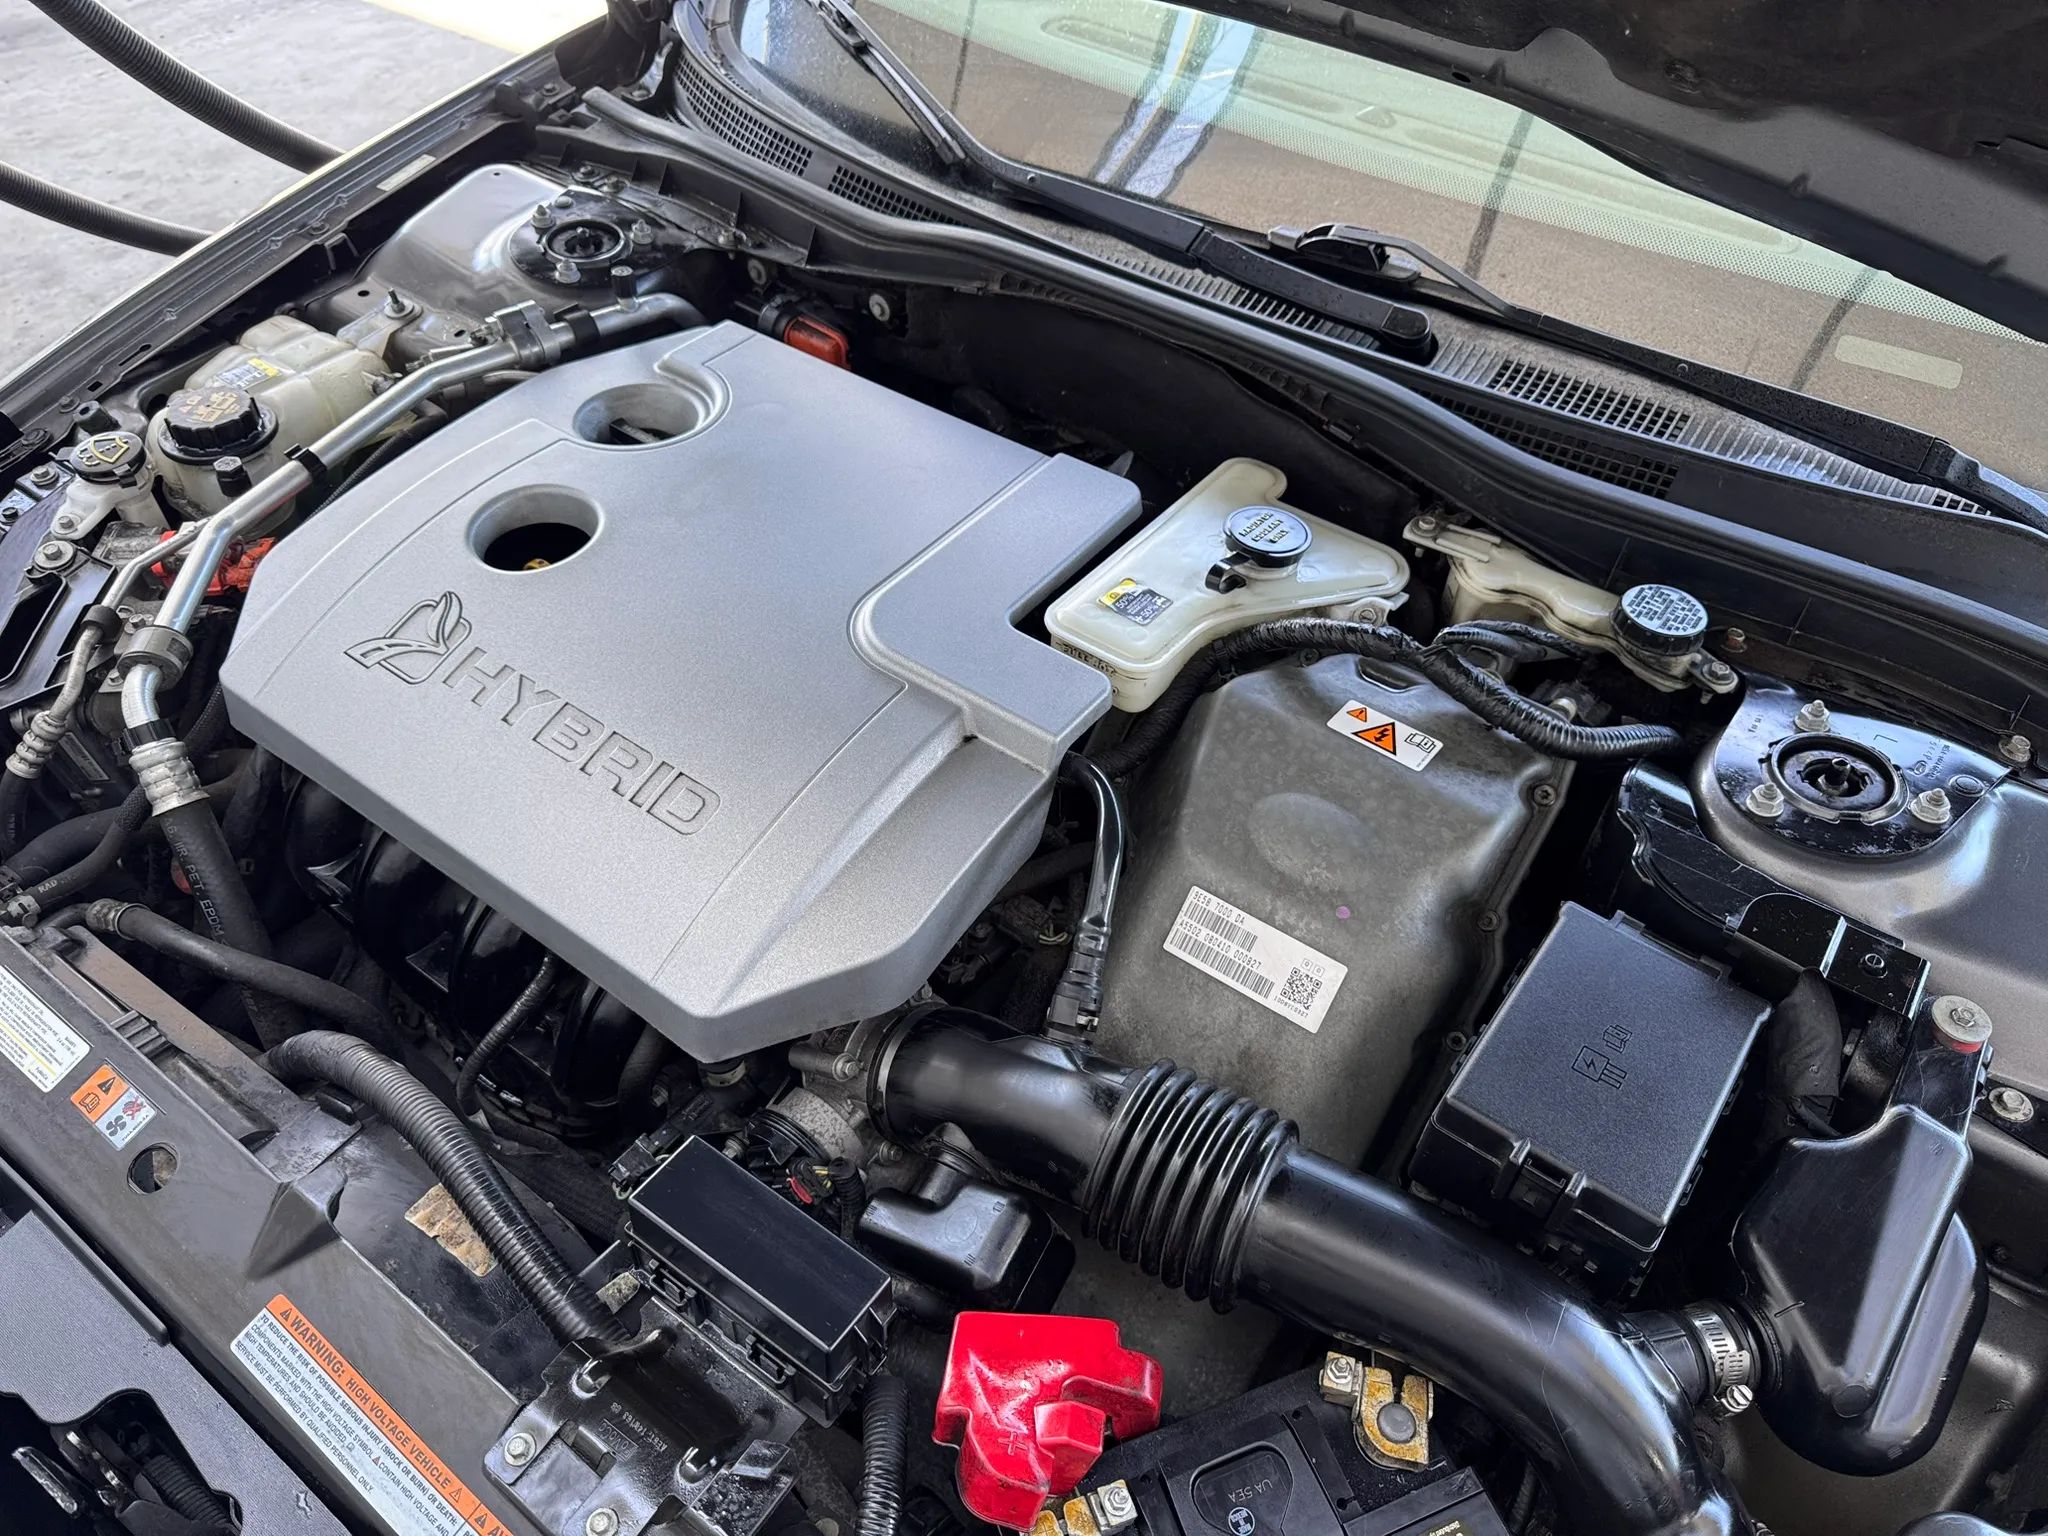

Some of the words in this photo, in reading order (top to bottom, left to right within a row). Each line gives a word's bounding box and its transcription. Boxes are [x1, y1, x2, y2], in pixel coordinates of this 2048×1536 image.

[442, 646, 721, 835] HYBRID
[199, 897, 225, 937] EPDM
[234, 1340, 255, 1362] SERVICE
[253, 1360, 267, 1375] MUST
[265, 1374, 274, 1383] BE
[272, 1382, 302, 1413] PERFORMED
[299, 1412, 308, 1420] BY
[305, 1419, 332, 1447] QUALIFIED
[329, 1445, 360, 1478] PERSONNEL
[244, 1331, 257, 1344] HIGH
[255, 1343, 291, 1381] TEMPERATURES
[288, 1380, 301, 1392] AND
[298, 1391, 319, 1412] SHOULD
[317, 1411, 326, 1420] BE
[250, 1323, 283, 1357] COMPONENTS
[280, 1356, 301, 1377] MARKED
[299, 1376, 313, 1390] WITH
[310, 1389, 322, 1401] THE
[320, 1399, 333, 1413] HIGH
[331, 1412, 355, 1436] VOLTAGE
[352, 1434, 375, 1457] SYMBOL
[378, 1462, 402, 1486] CONTAIN
[399, 1485, 414, 1500] HIGH
[412, 1498, 437, 1524] VOLTAGE
[435, 1523, 449, 1536] AND
[260, 1314, 269, 1323] TO
[267, 1322, 288, 1343] REDUCE
[287, 1343, 298, 1354] THE
[297, 1353, 310, 1367] RISK
[308, 1366, 317, 1375] OF
[315, 1374, 341, 1401] POSSIBLE
[339, 1400, 363, 1425] SERIOUS
[361, 1423, 382, 1445] INJURY
[380, 1444, 403, 1467] (SHOCK
[401, 1466, 411, 1476] OR
[409, 1474, 429, 1495] BURN)
[427, 1493, 437, 1504] OR
[435, 1502, 458, 1526] DEATH:
[289, 1316, 348, 1377] WARNING:
[345, 1378, 371, 1404] HIGH
[368, 1402, 411, 1446] VOLTAGE
[408, 1444, 451, 1488] VEHICLE
